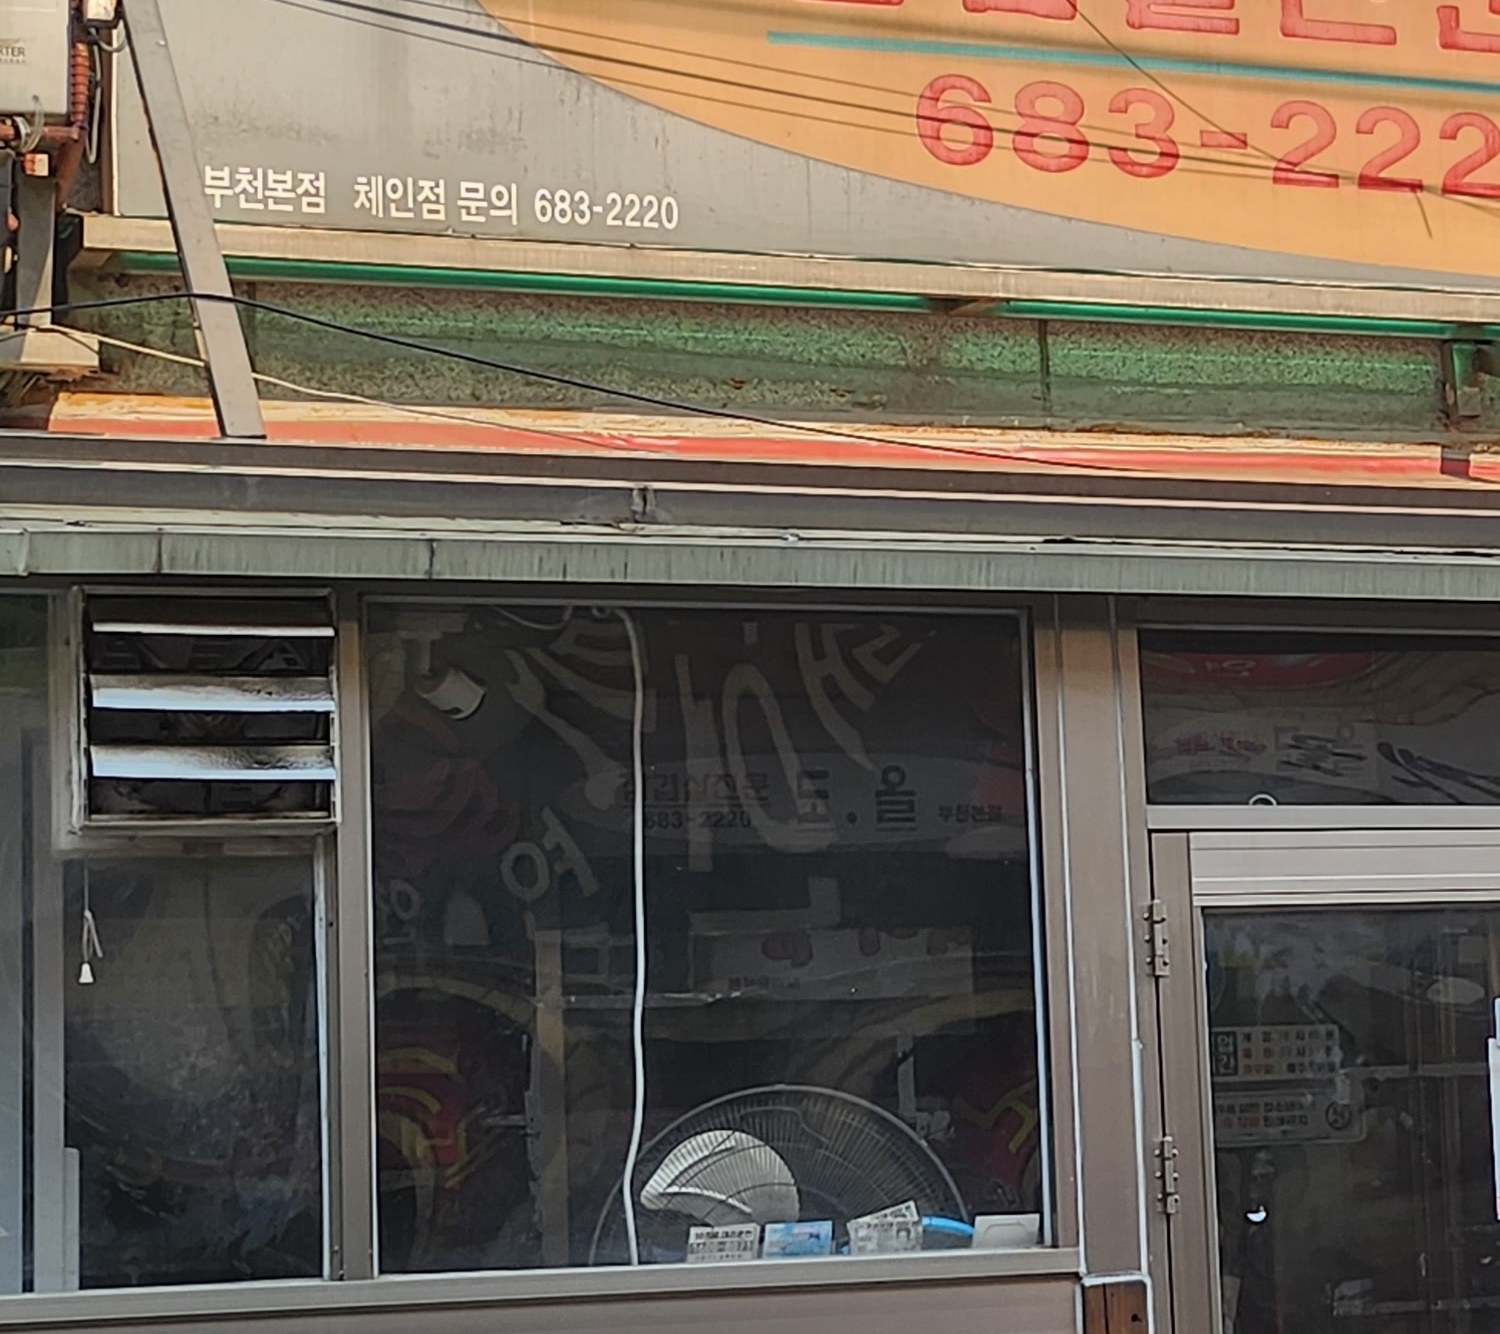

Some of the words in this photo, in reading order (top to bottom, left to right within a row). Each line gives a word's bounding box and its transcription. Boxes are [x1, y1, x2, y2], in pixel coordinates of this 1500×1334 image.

[203, 164, 326, 214] 부천본점
[353, 175, 446, 221] 체인점
[456, 180, 519, 226] 문의
[534, 188, 680, 231] 683-2220
